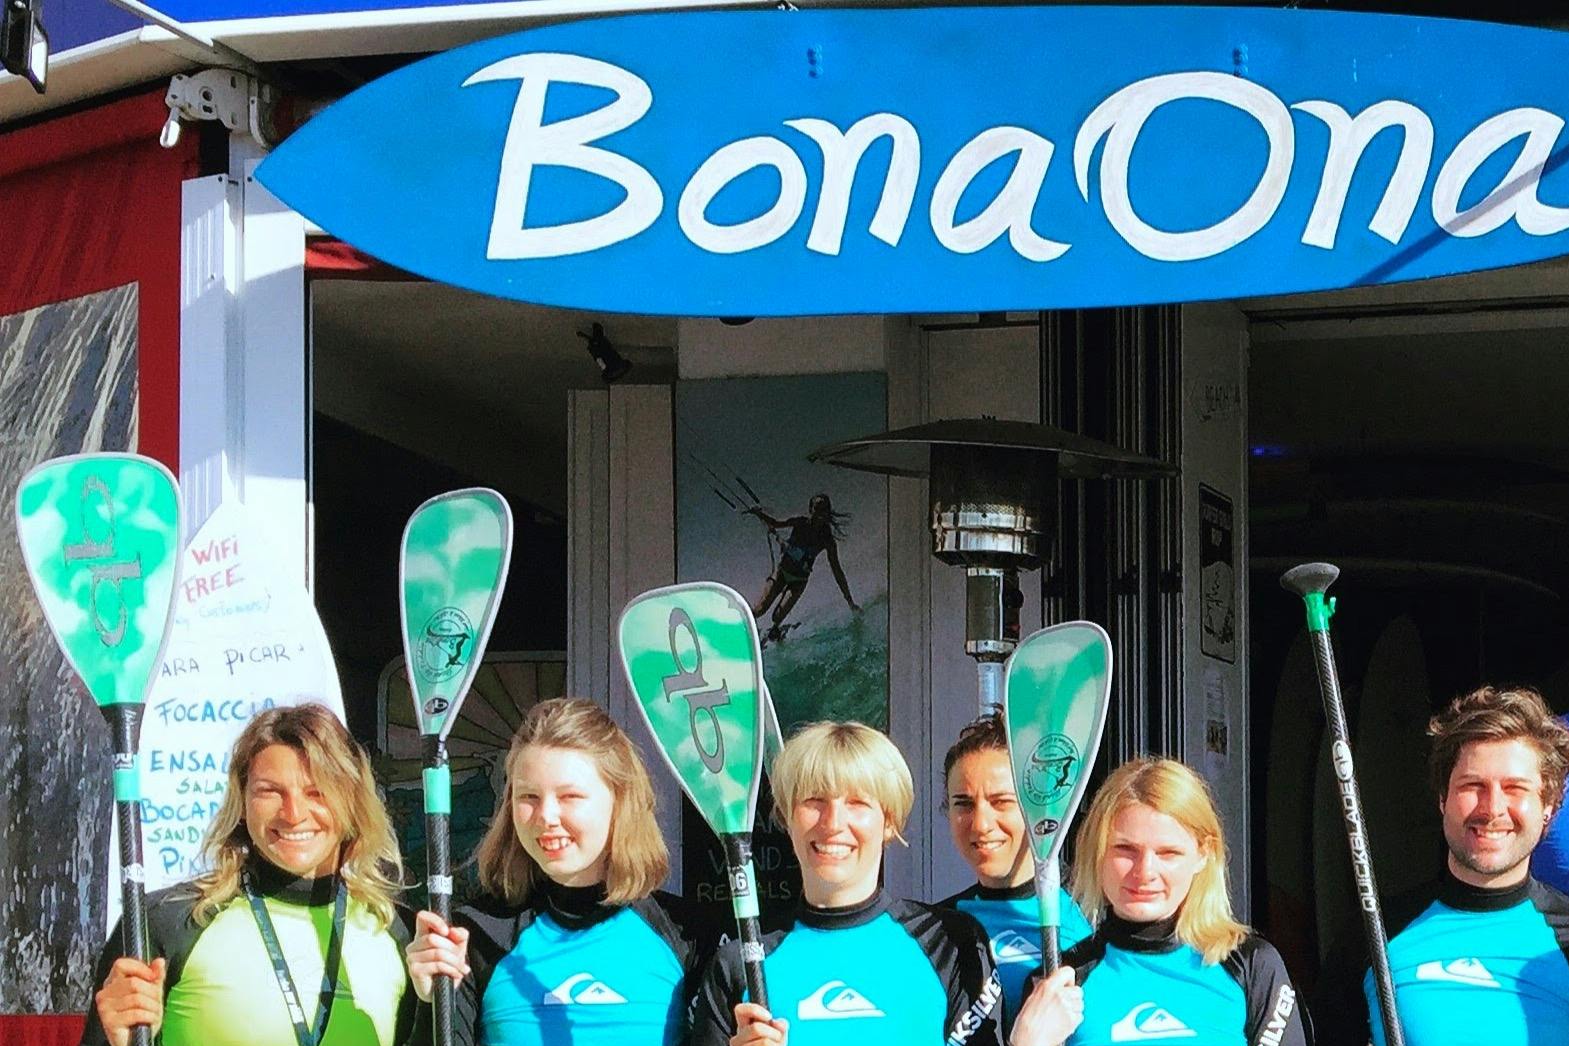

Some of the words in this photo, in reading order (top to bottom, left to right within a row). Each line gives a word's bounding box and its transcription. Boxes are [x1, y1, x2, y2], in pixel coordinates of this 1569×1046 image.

[181, 563, 246, 603] FREE
[161, 657, 200, 678] ARA
[150, 749, 230, 775] ENSAL
[176, 777, 226, 795] SALA
[147, 826, 202, 844] SAND
